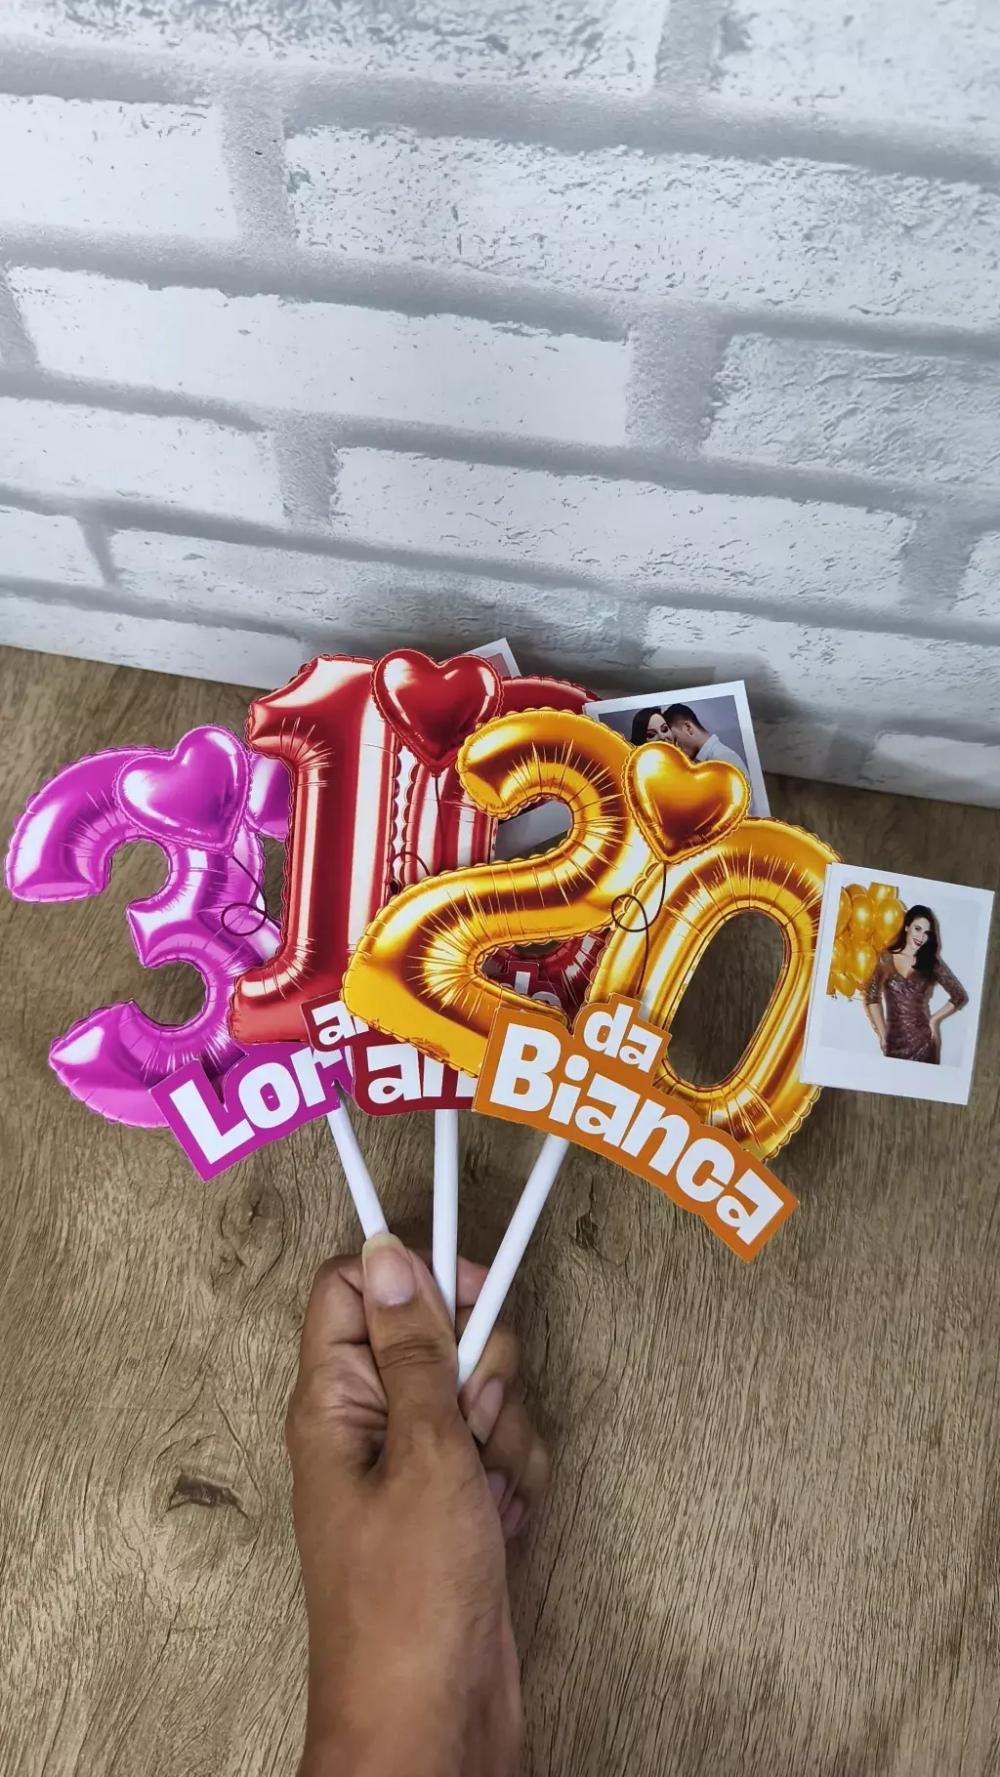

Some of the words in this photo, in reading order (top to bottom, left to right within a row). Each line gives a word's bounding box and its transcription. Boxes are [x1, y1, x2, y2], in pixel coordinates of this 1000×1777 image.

[5, 745, 290, 1127] 3
[342, 707, 841, 1162] 20
[583, 1003, 663, 1072] da
[169, 1046, 353, 1165] Lor
[489, 1023, 785, 1245] Bianca
